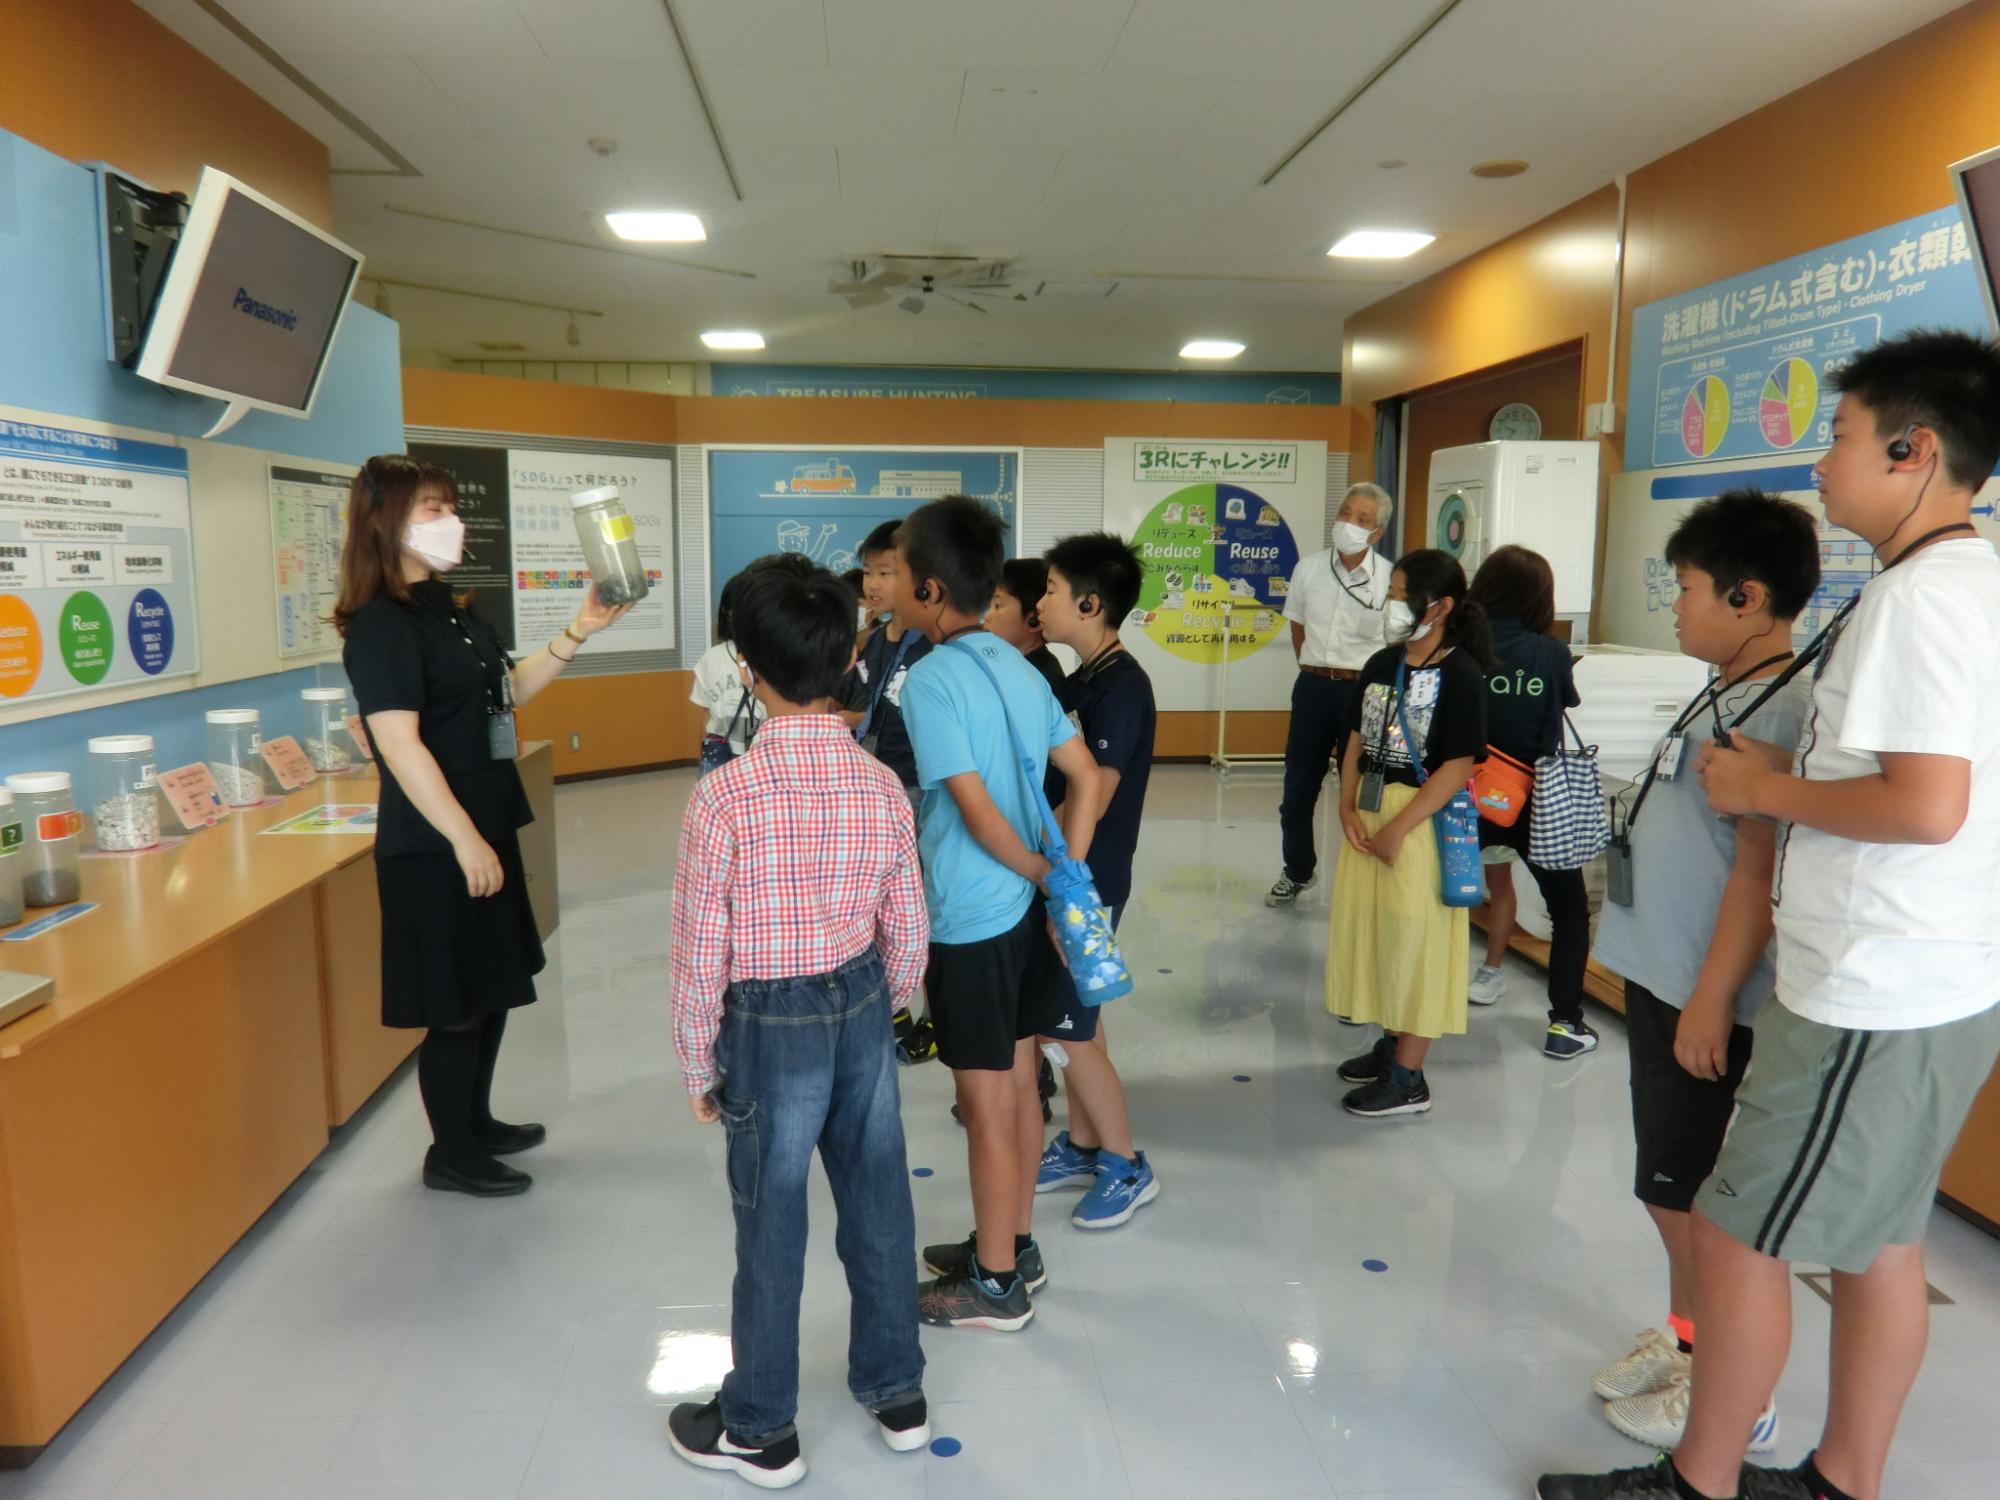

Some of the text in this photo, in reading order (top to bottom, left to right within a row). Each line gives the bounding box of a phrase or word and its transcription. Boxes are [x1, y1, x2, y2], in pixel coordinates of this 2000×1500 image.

[1850, 289, 1893, 308] Clothing
[1895, 279, 1928, 297] Dryer
[234, 287, 297, 332] Panasonic
[1142, 541, 1202, 559] Reduce
[1229, 542, 1280, 560] Reuse
[136, 602, 164, 618] Recycle
[72, 614, 101, 631] Reuse
